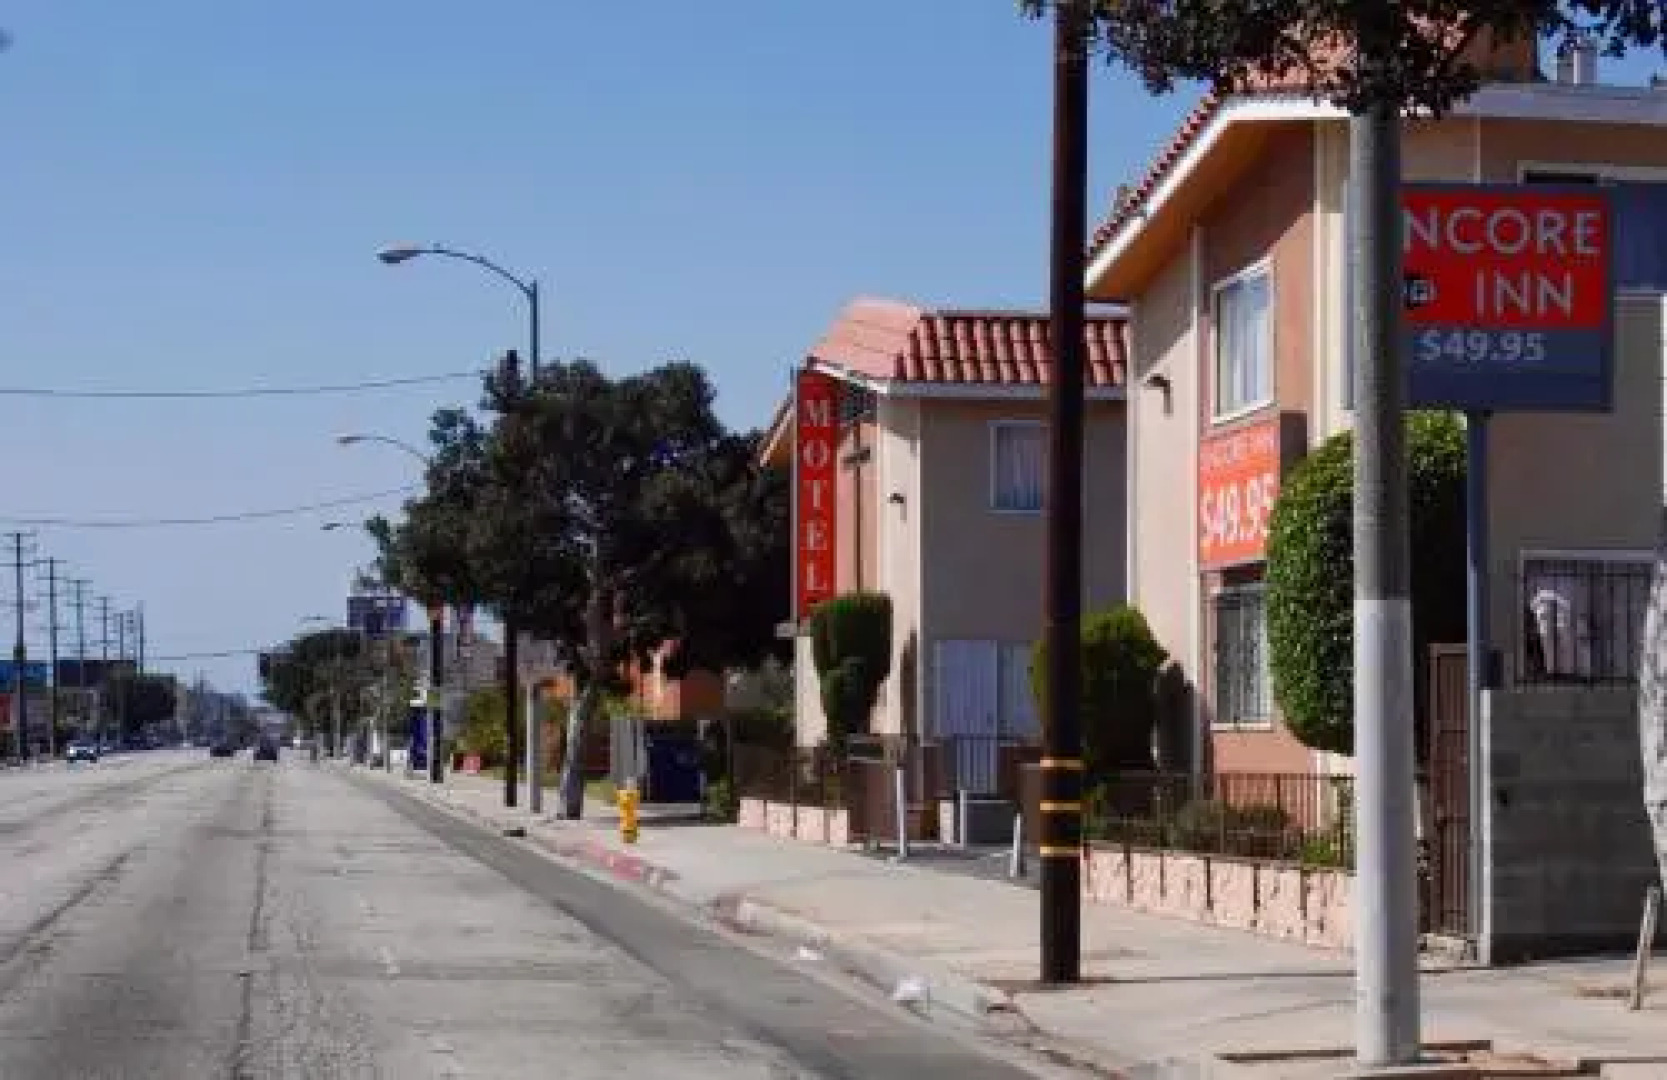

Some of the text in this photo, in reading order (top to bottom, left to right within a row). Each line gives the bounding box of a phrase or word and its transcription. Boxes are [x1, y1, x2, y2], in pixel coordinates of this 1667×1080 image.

[1402, 206, 1600, 254] NCORE
[1475, 269, 1573, 318] INN
[1418, 328, 1545, 361] $49.95
[803, 398, 830, 592] MOTEL
